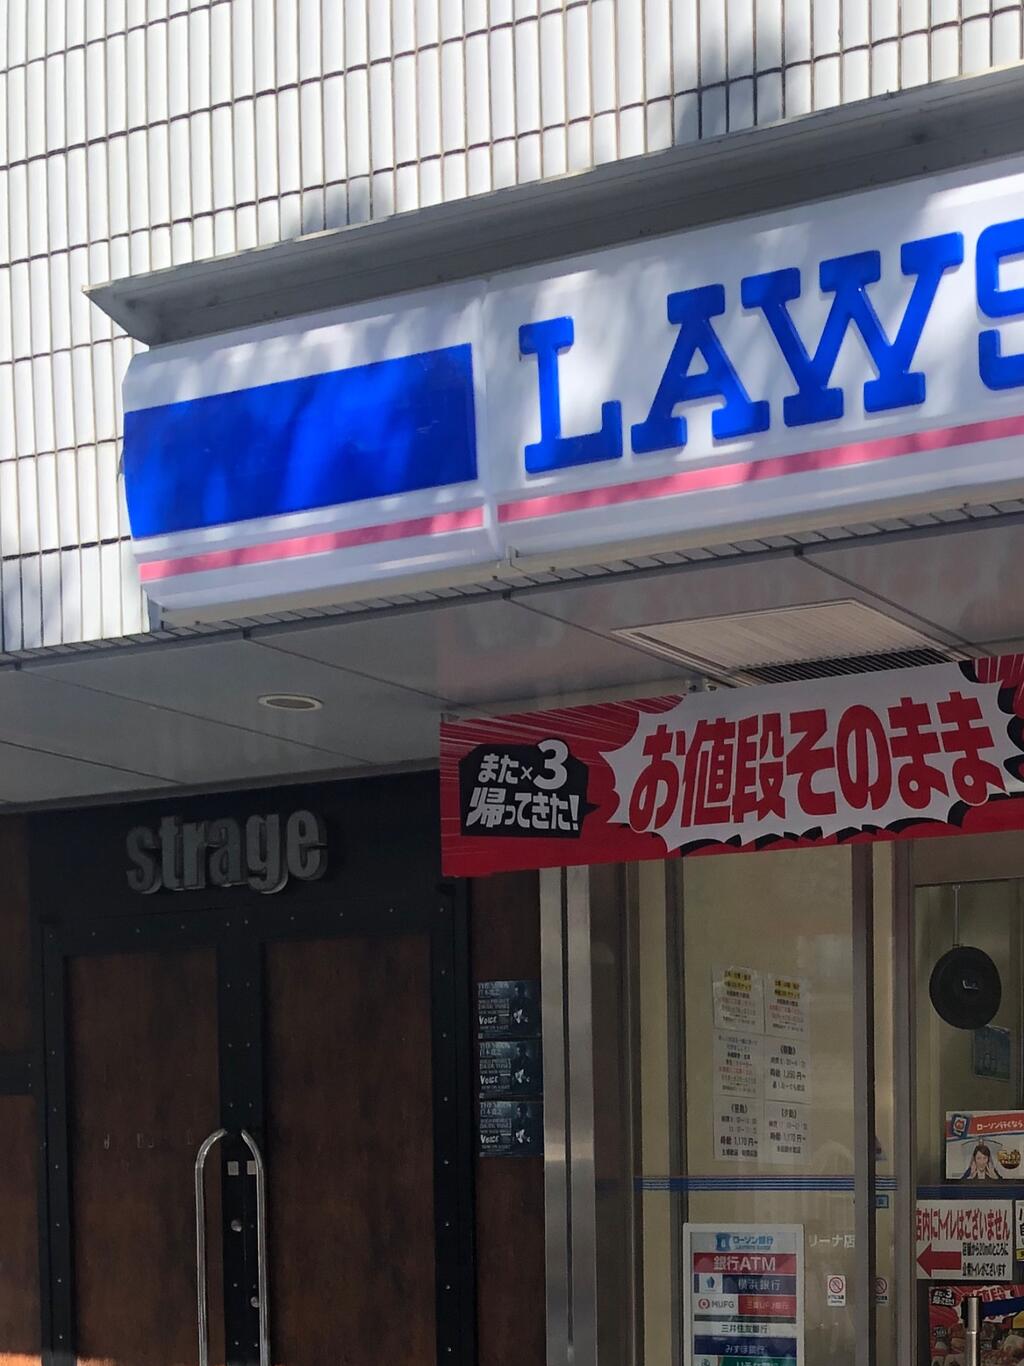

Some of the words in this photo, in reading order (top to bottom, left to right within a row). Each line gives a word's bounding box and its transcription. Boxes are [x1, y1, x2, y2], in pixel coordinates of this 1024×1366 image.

[628, 689, 1007, 833] お値段そのまま
[465, 787, 580, 832] 帰ってきた!
[126, 809, 328, 895] strage
[713, 1256, 776, 1271] 銀行ATM
[737, 1278, 781, 1291] 横浜銀行
[711, 1300, 735, 1308] MUFG
